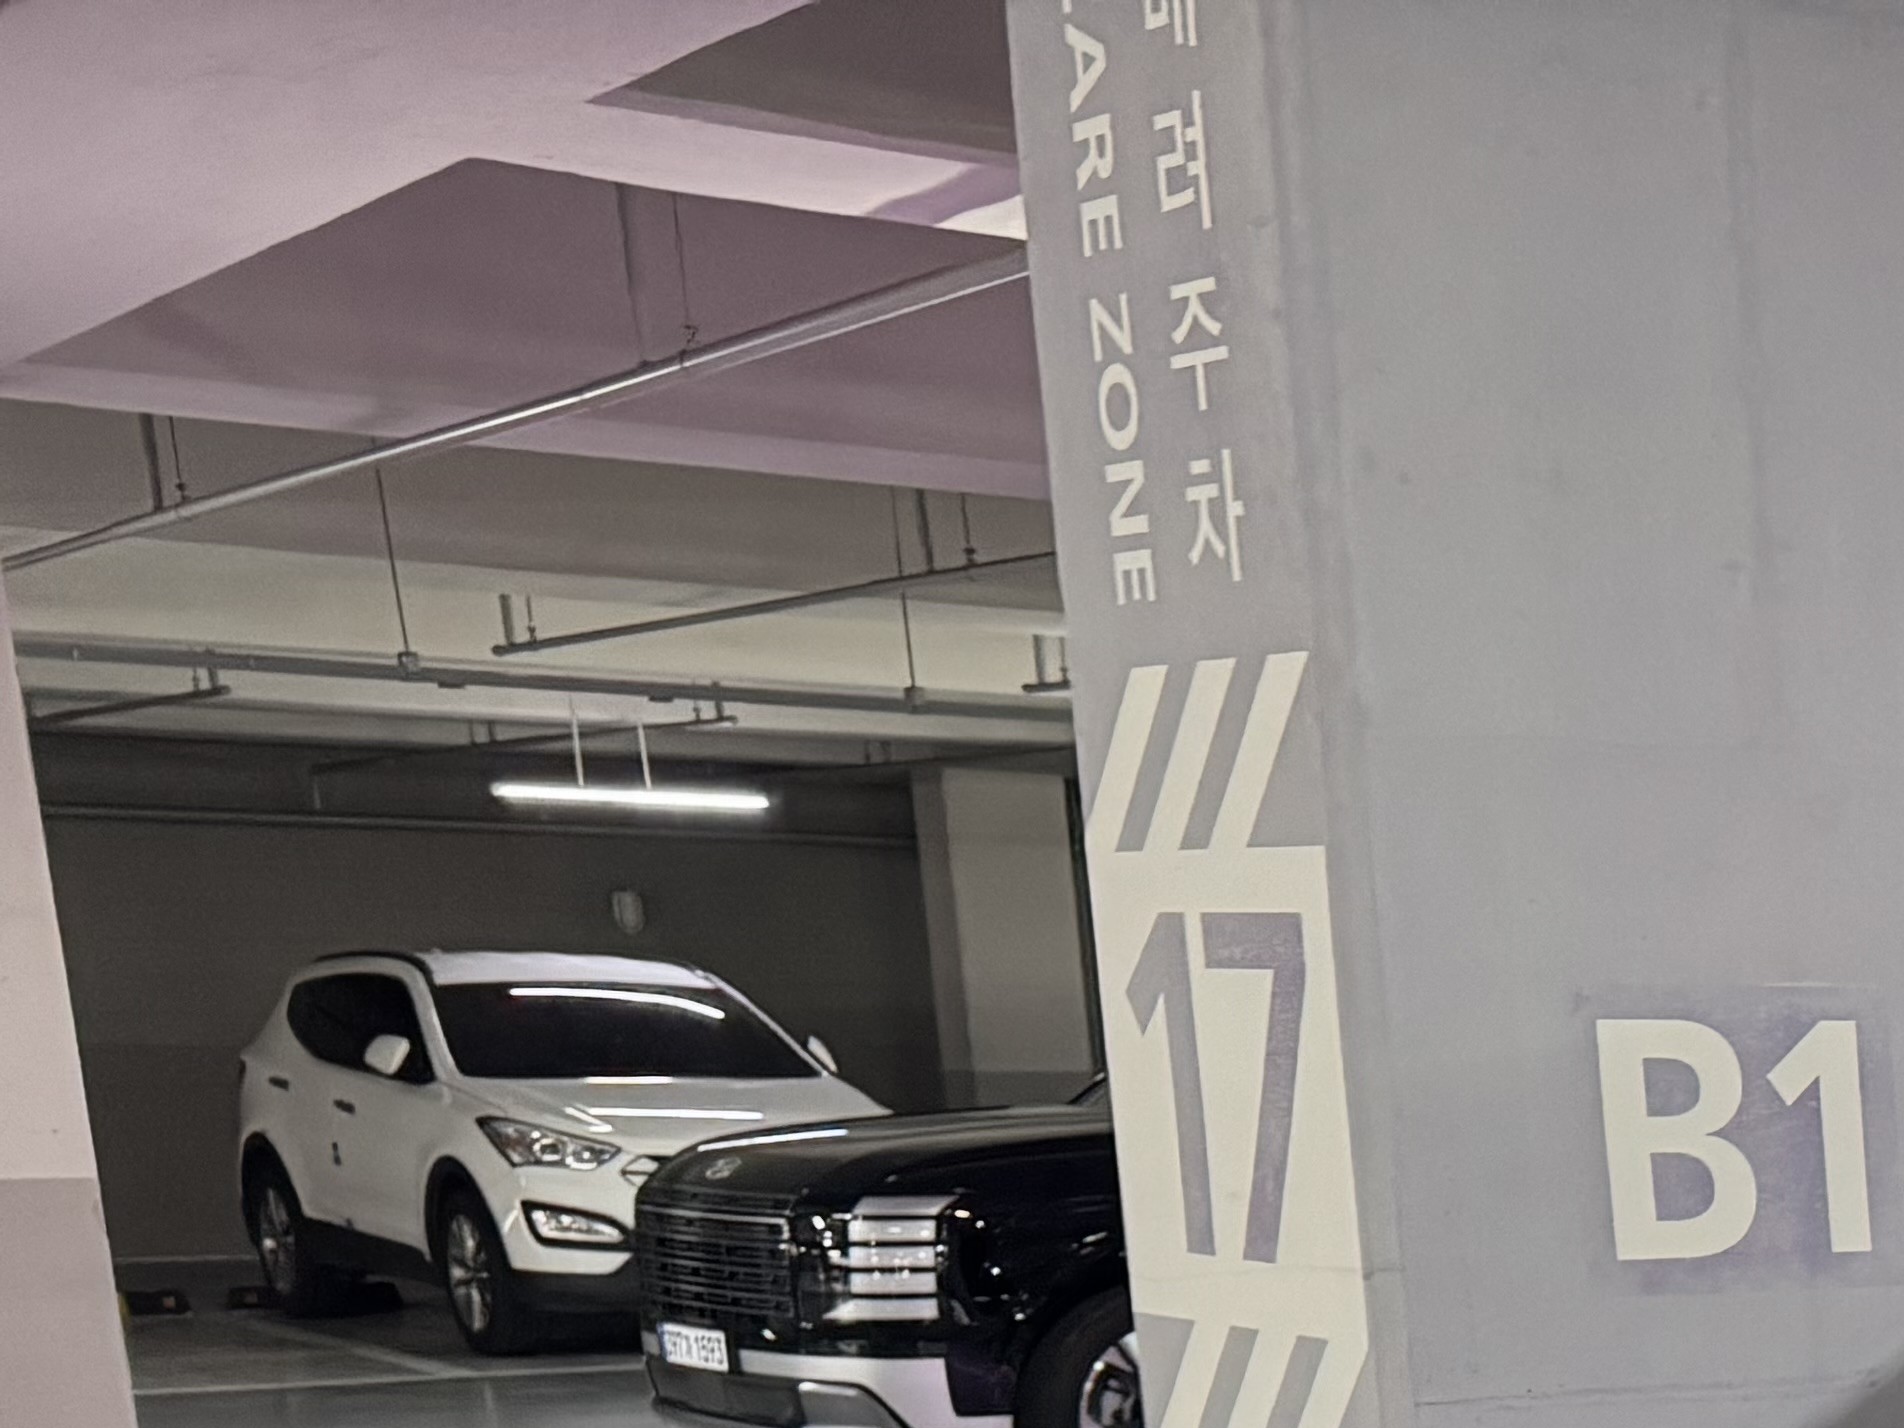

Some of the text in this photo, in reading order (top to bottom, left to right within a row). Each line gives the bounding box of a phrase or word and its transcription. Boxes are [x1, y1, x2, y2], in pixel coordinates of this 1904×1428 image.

[1062, 0, 1156, 606] ARE ZONE
[1125, 910, 1307, 1265] 17
[1596, 1018, 1874, 1261] B1
